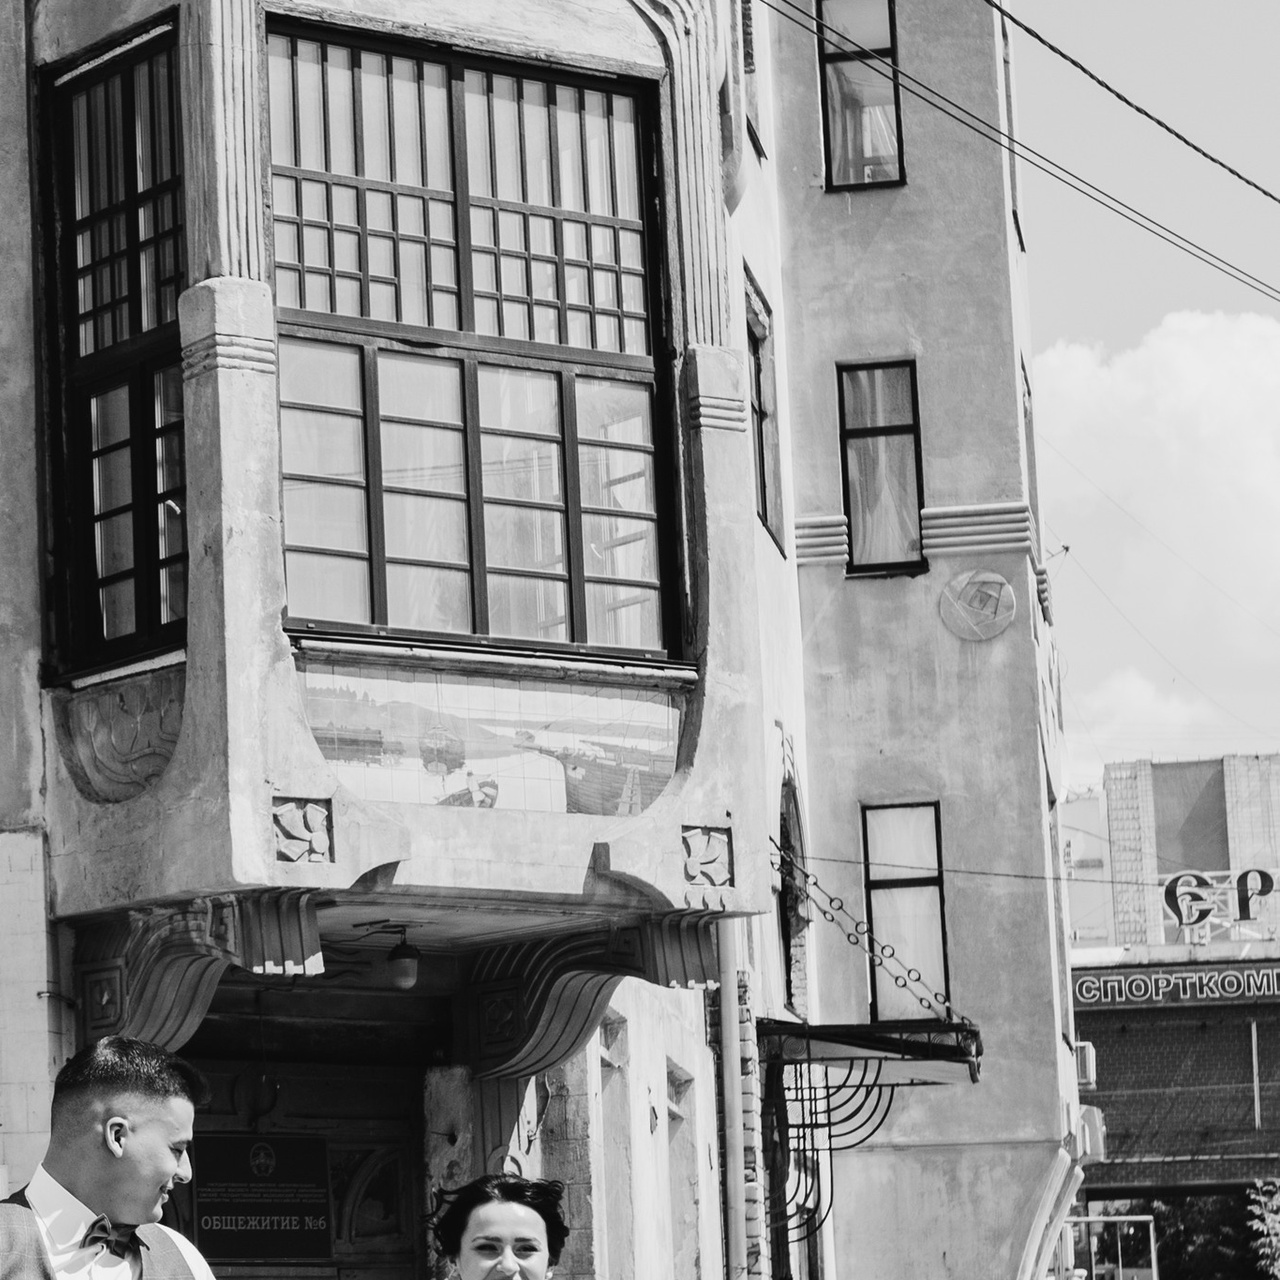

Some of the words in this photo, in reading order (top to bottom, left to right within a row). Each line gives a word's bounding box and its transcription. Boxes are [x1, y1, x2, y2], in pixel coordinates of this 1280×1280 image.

[1075, 968, 1280, 1003] СПОРТКОМ
[201, 1215, 300, 1232] ОБЩЕЖИТИЕ
[304, 1215, 326, 1230] №6
